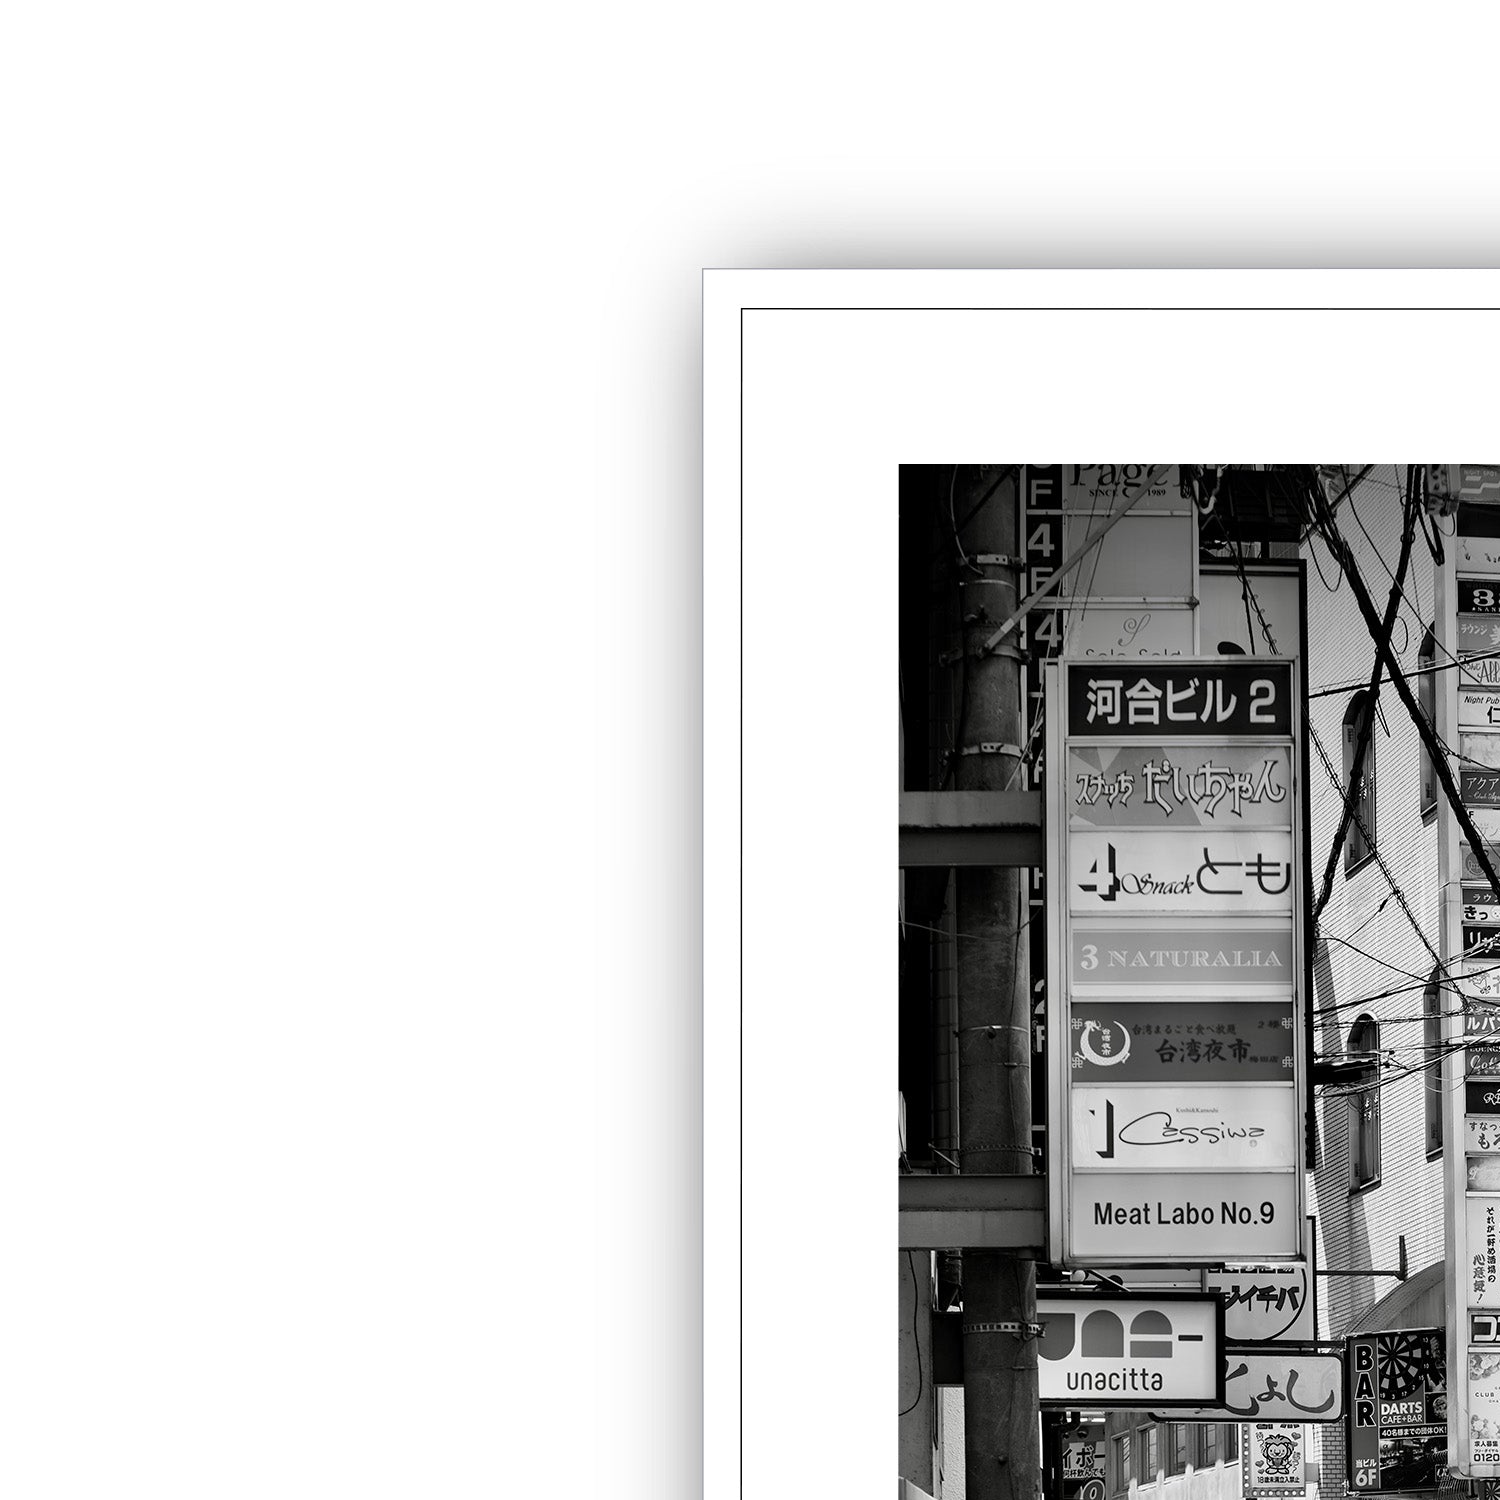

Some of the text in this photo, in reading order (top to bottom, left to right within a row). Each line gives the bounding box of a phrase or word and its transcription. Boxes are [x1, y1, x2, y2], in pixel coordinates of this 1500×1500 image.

[1146, 488, 1167, 498] 1989
[1086, 677, 1277, 726] 河合ビル 2
[1464, 695, 1500, 705] Night Pub
[1078, 842, 1291, 902] 4 Snack とも
[1079, 944, 1284, 970] 3 NATURALIA
[1154, 1038, 1251, 1065] 台湾夜市
[1093, 1201, 1275, 1226] Meat Labo No.9
[1066, 1368, 1165, 1393] unacitta
[1354, 1343, 1377, 1428] BAR
[1381, 1401, 1424, 1417] DARTS
[1355, 1468, 1378, 1487] 6F
